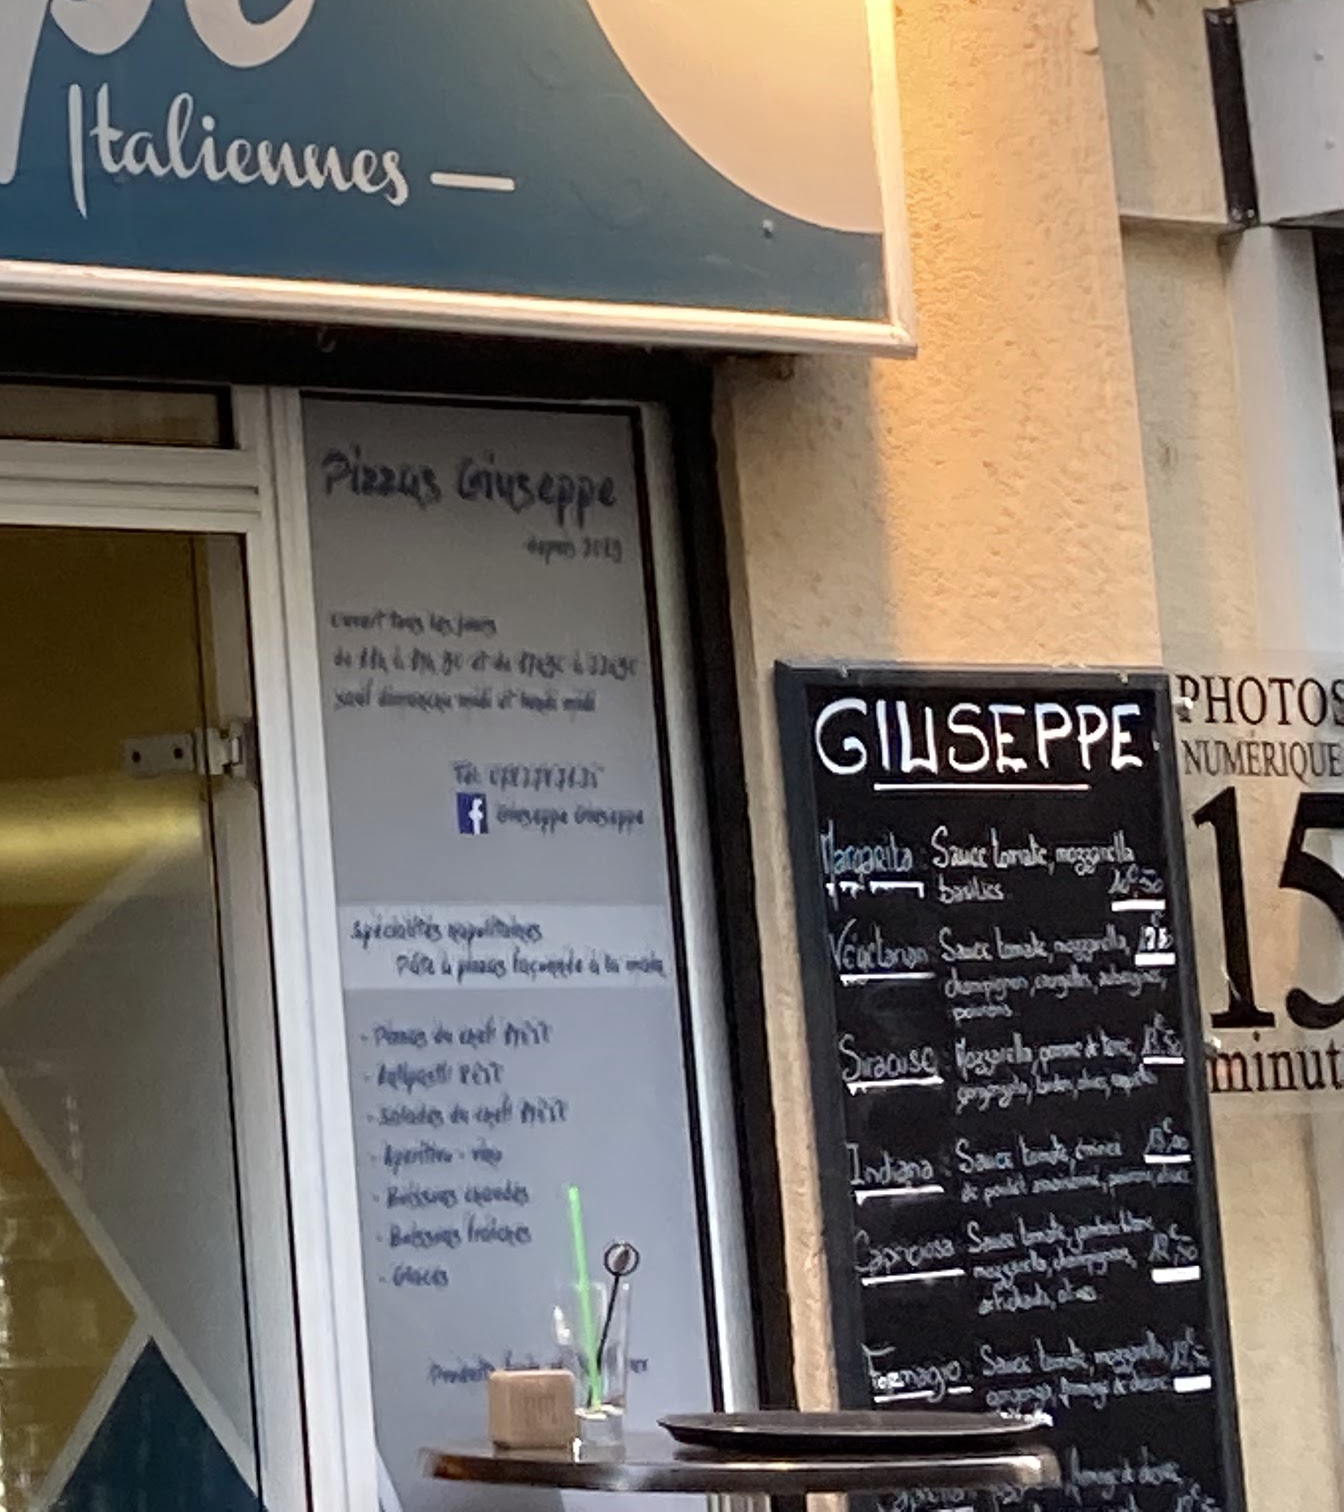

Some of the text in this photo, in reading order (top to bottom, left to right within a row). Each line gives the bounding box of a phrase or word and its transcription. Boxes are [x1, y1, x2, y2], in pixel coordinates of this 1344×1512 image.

[68, 83, 409, 219] Italiennes
[456, 448, 617, 529] Giuseppe
[814, 697, 1144, 776] GIUSEPPE
[1192, 786, 1344, 1030] 15
